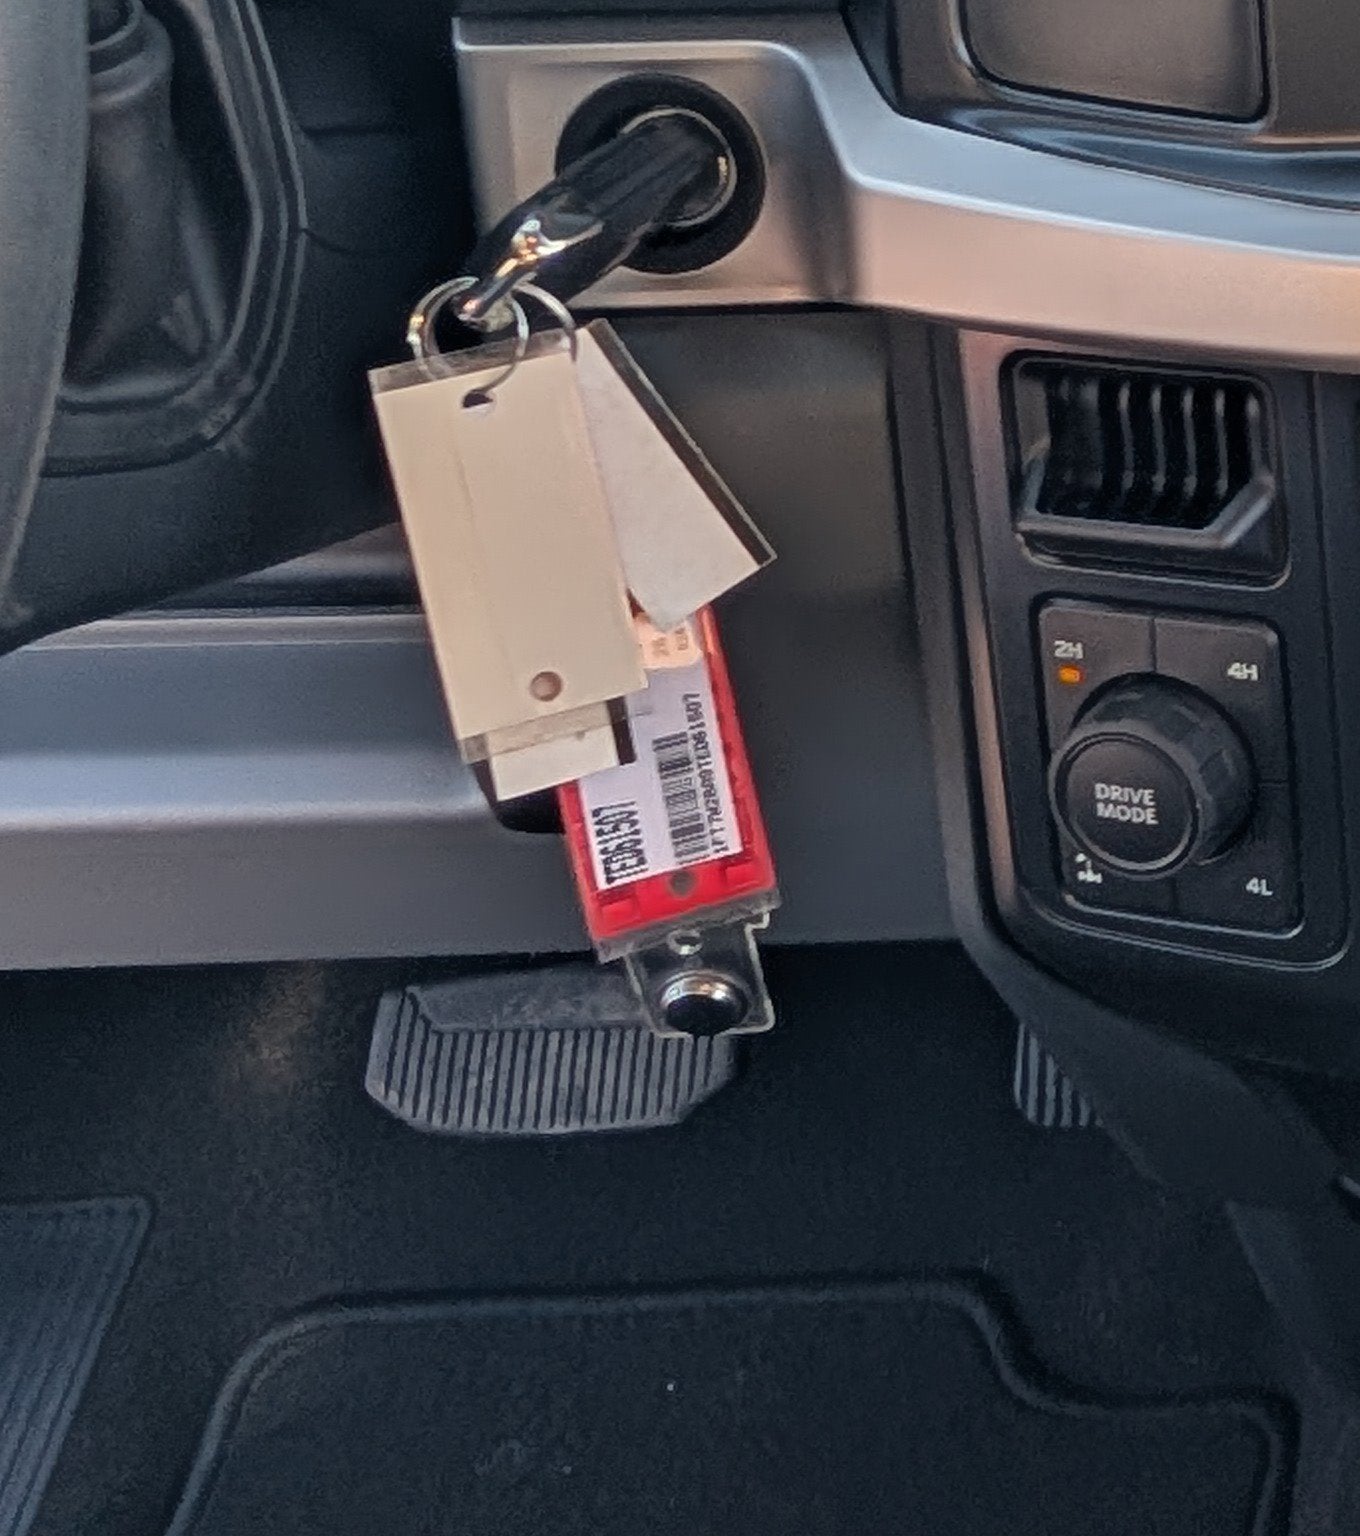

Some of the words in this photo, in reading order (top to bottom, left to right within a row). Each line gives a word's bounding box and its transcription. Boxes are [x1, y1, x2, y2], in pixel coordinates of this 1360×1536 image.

[1054, 640, 1083, 659] 2H
[1227, 662, 1259, 681] 4H
[1095, 782, 1156, 806] DRIVE
[1096, 802, 1160, 825] MODE
[1246, 877, 1274, 897] 4L
